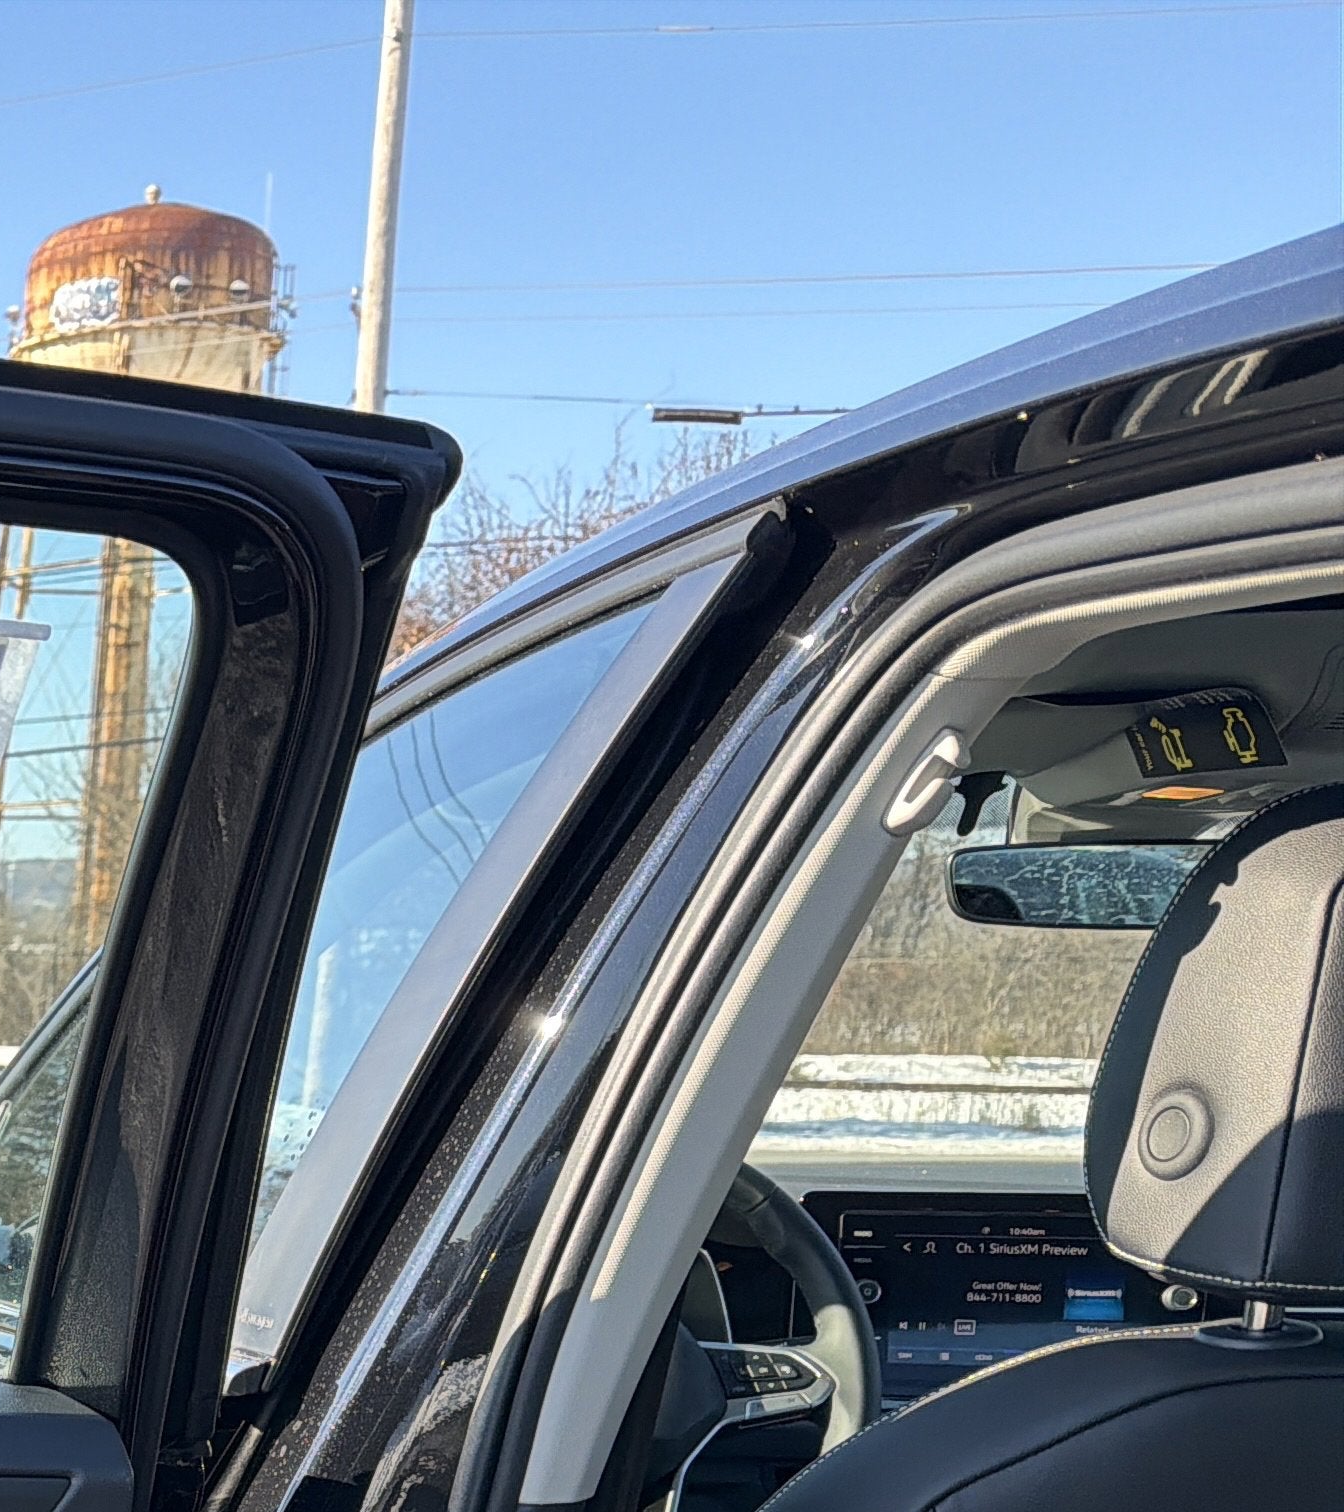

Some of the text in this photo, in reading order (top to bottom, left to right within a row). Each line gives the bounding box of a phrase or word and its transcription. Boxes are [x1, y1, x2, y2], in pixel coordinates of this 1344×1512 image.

[1009, 1227, 1046, 1236] 10:40am
[955, 1242, 1089, 1256] Ch. 1 SiriusXM Preview
[972, 1281, 1043, 1292] Great Offer Now!
[966, 1292, 1042, 1303] 844-711-8800
[1075, 1325, 1110, 1334] Related
